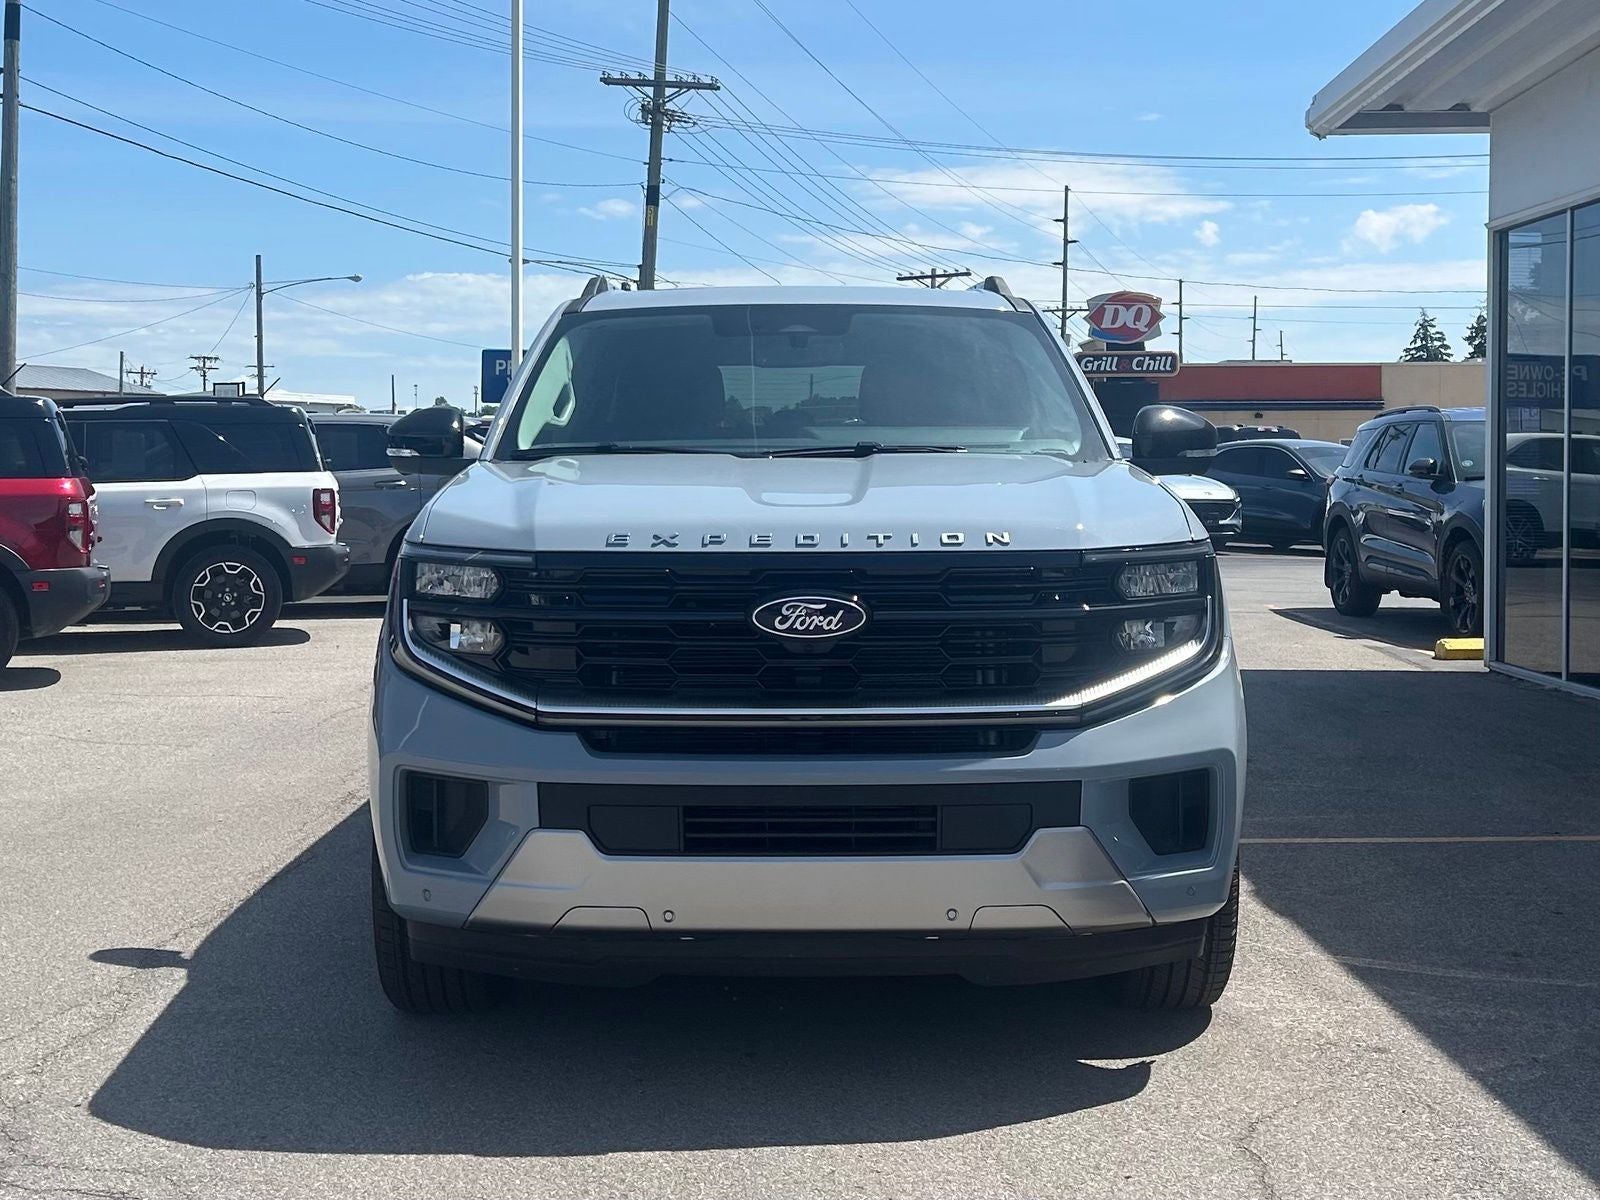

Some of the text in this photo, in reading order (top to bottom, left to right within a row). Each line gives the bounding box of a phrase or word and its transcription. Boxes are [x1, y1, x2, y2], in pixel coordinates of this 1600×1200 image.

[1101, 304, 1152, 332] DQ
[1080, 356, 1118, 372] Grill
[1131, 356, 1173, 371] Chill
[606, 531, 1011, 548] EXPEDITION
[774, 602, 844, 630] Ford
